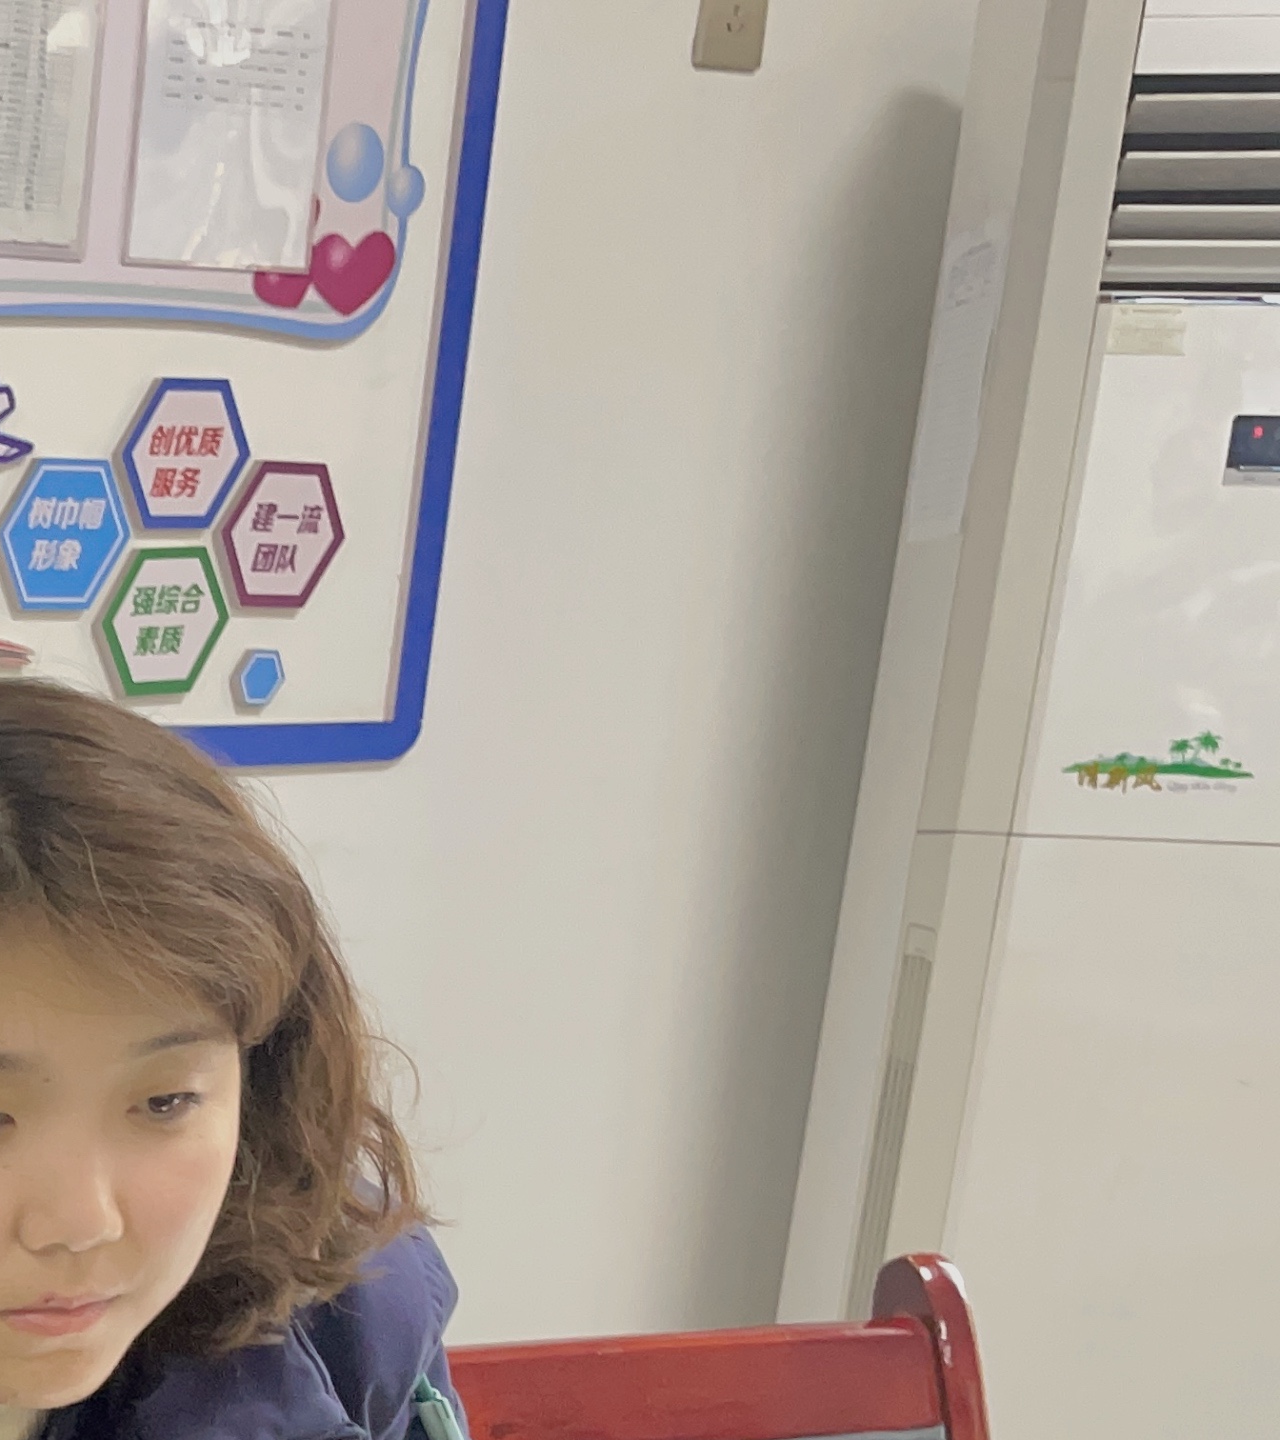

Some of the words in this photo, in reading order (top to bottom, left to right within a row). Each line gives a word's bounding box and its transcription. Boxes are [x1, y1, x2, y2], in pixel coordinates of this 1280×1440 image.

[149, 425, 224, 456] 创优质
[149, 467, 201, 498] 服务
[251, 502, 324, 534] 建一流
[28, 539, 82, 571] 形象
[251, 543, 297, 574] 团队
[131, 583, 204, 617] 强综合
[133, 624, 184, 656] 素质
